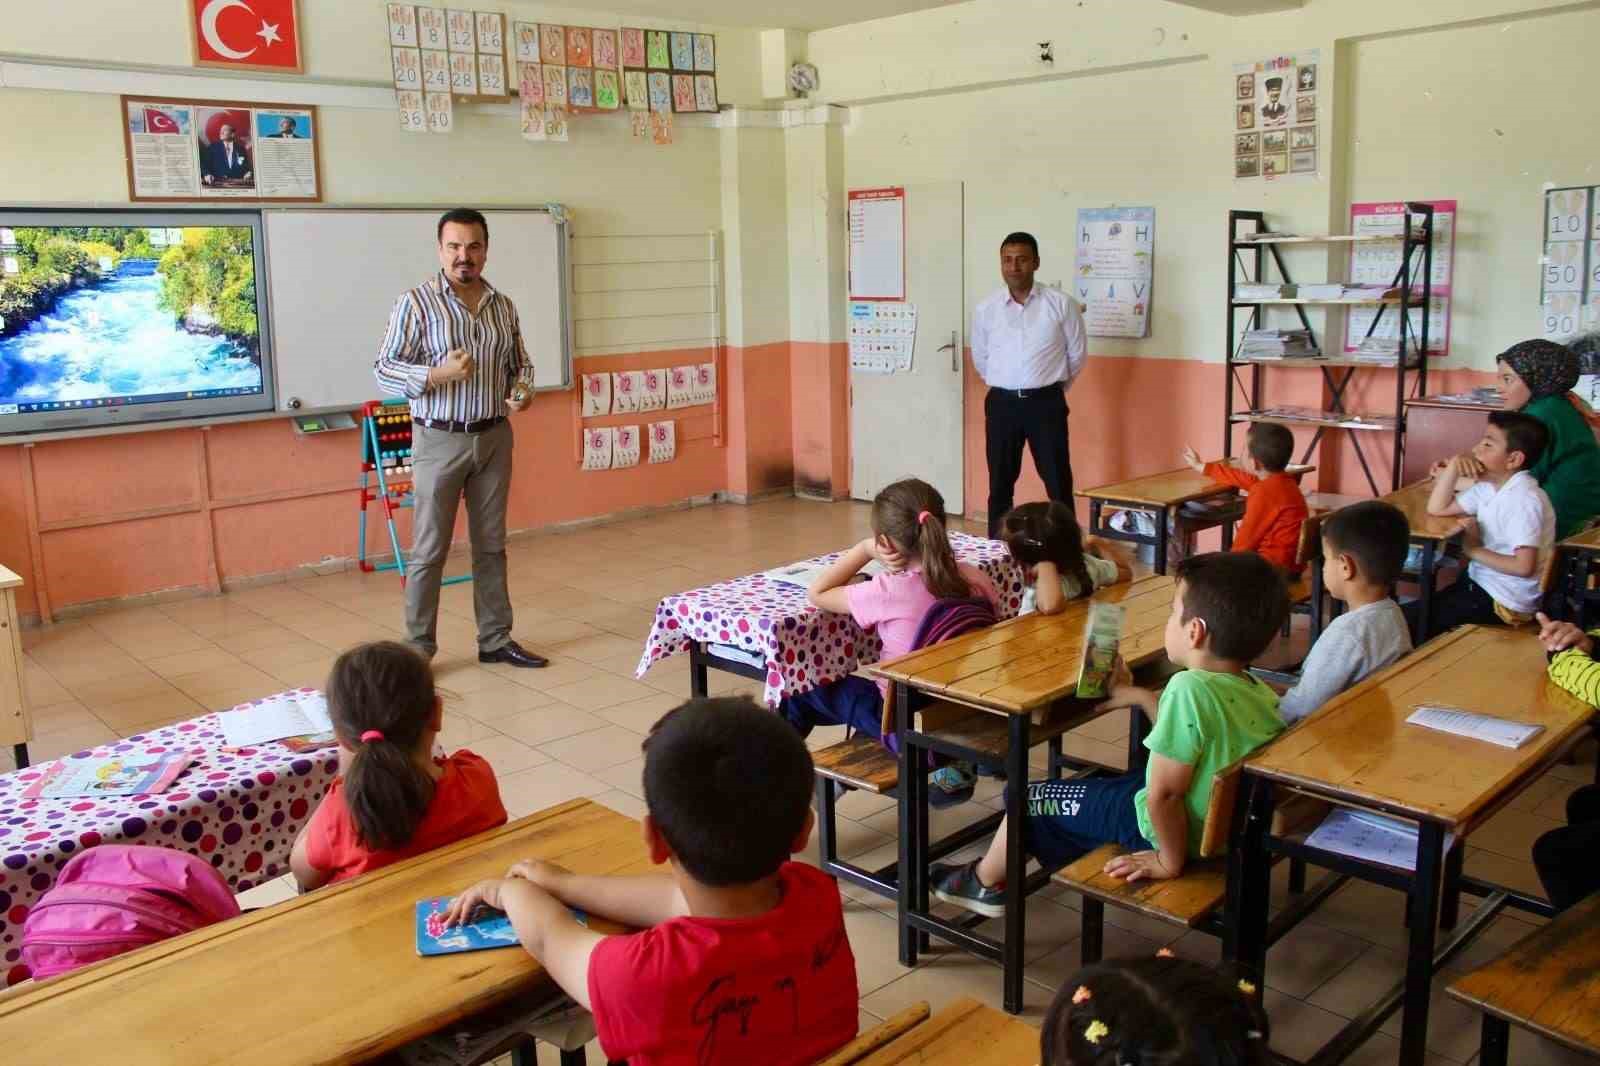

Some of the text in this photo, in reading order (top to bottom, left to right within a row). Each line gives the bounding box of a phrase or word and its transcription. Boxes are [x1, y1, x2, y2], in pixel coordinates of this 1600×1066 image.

[397, 25, 500, 47] 4 8 12 16
[396, 68, 500, 88] 20 24 28 32
[400, 111, 448, 127] 36 40
[1551, 214, 1580, 233] 10
[1136, 226, 1148, 241] H
[1548, 265, 1576, 284] 50
[1133, 281, 1145, 299] V
[1546, 316, 1573, 334] 90
[623, 378, 632, 391] 2
[649, 375, 657, 389] 3
[675, 372, 684, 385] 4
[699, 369, 708, 382] 5
[595, 435, 603, 448] 6
